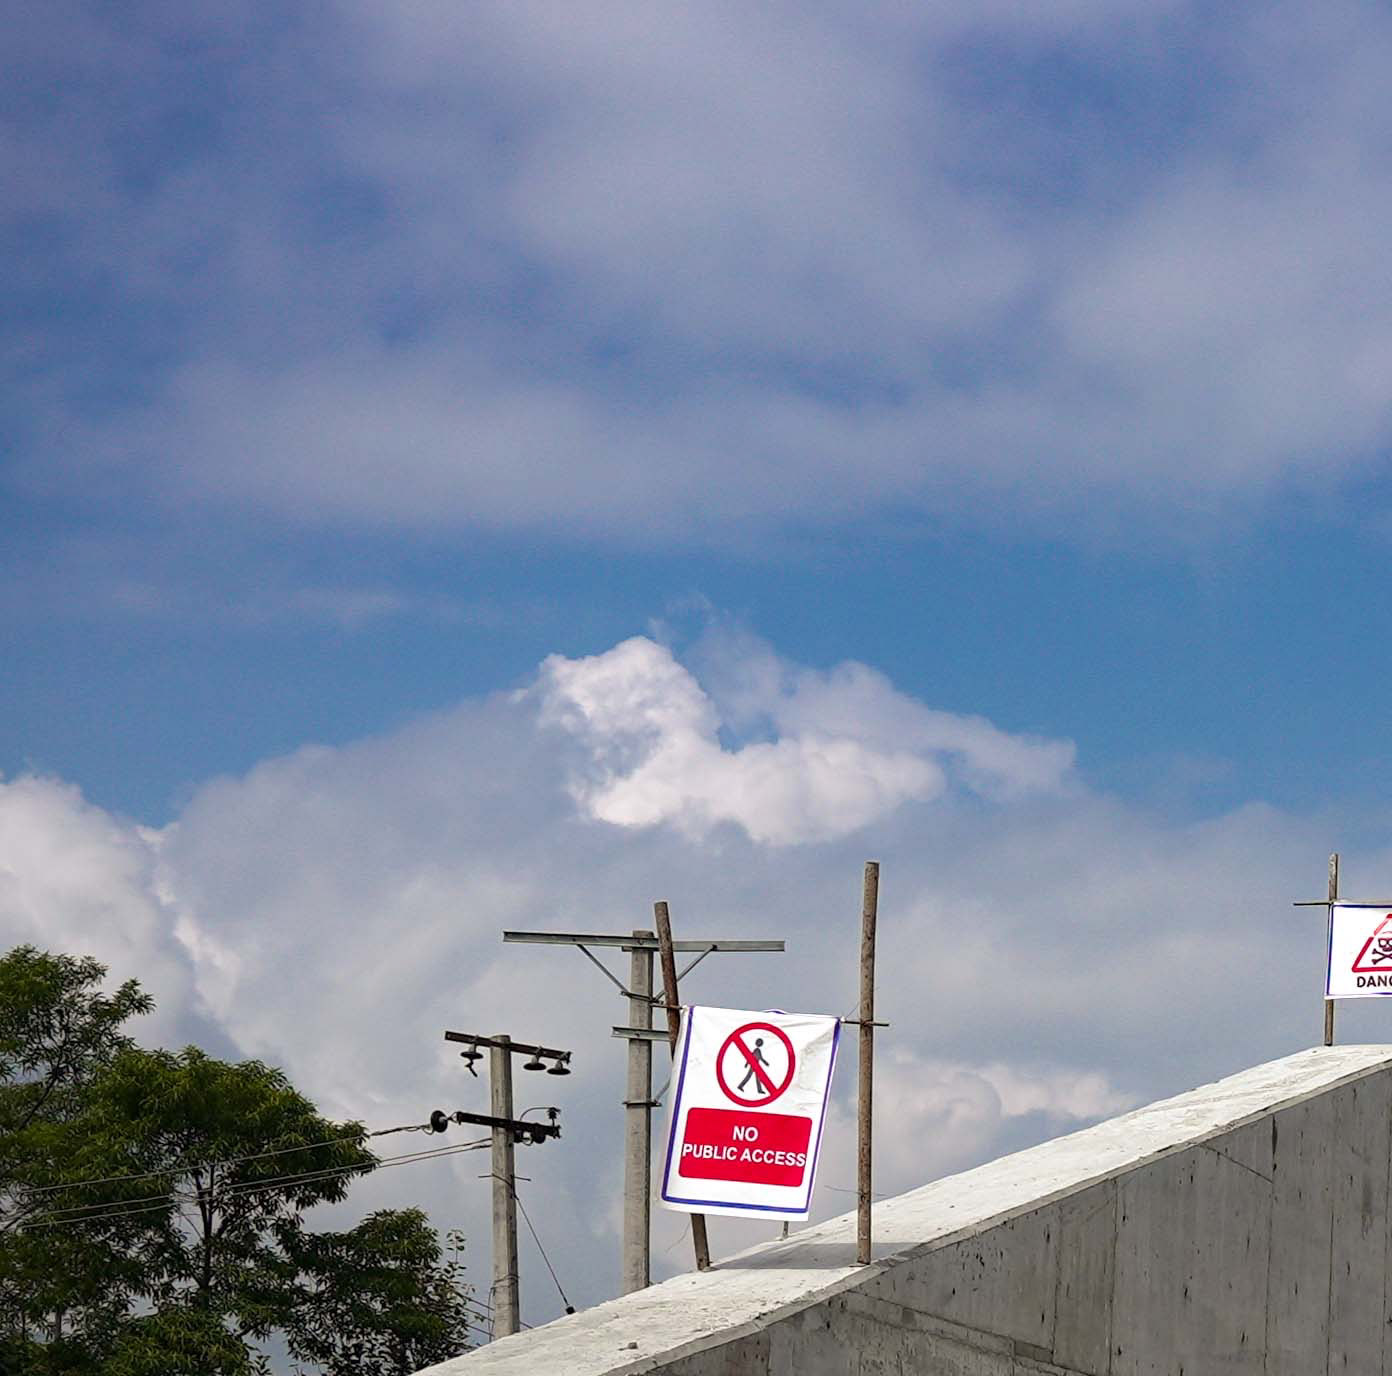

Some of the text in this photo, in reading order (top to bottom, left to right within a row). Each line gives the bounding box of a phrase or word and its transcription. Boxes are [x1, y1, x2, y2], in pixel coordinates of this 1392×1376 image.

[732, 1125, 759, 1142] NO
[682, 1143, 806, 1167] PUBLIC ACCESS
